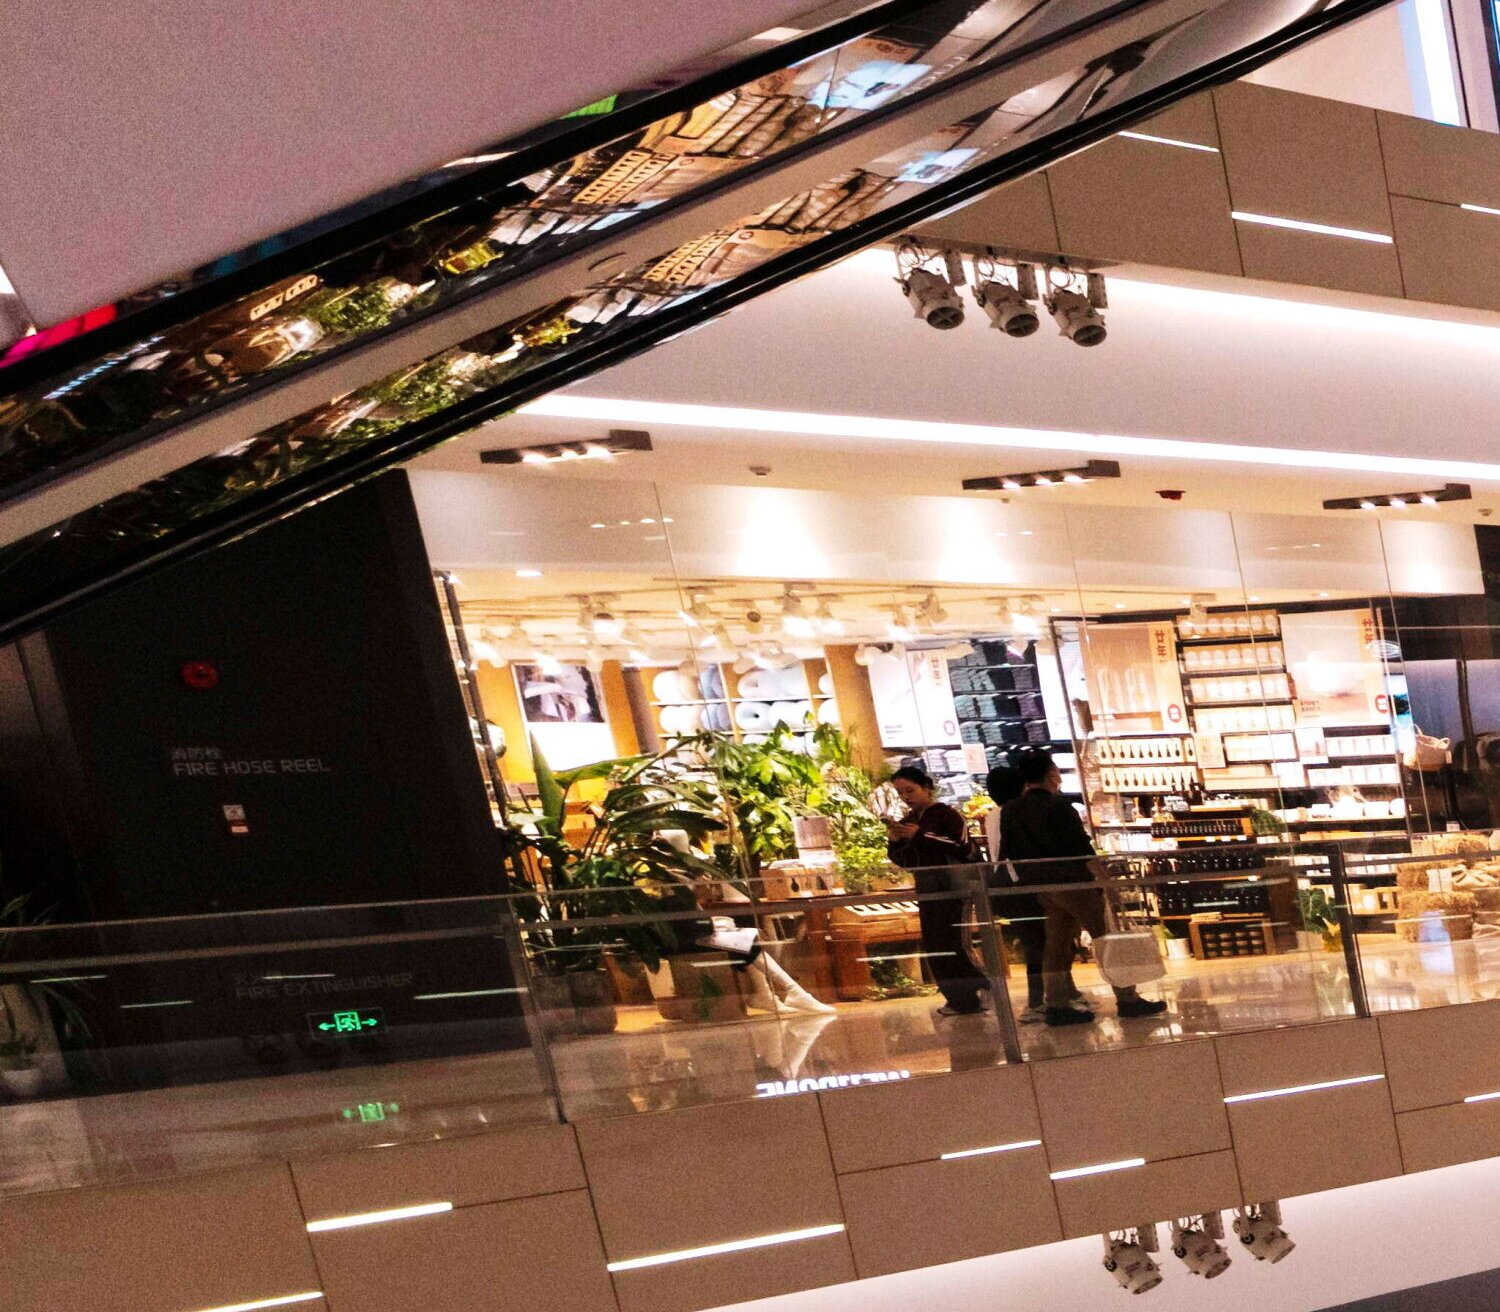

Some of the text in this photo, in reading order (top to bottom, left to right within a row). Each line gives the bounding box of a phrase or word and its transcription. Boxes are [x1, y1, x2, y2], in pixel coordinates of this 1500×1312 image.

[173, 758, 330, 777] FIRE HOSE REEL
[235, 986, 277, 999] FIRE
[283, 972, 413, 995] EXTINGUISHER
